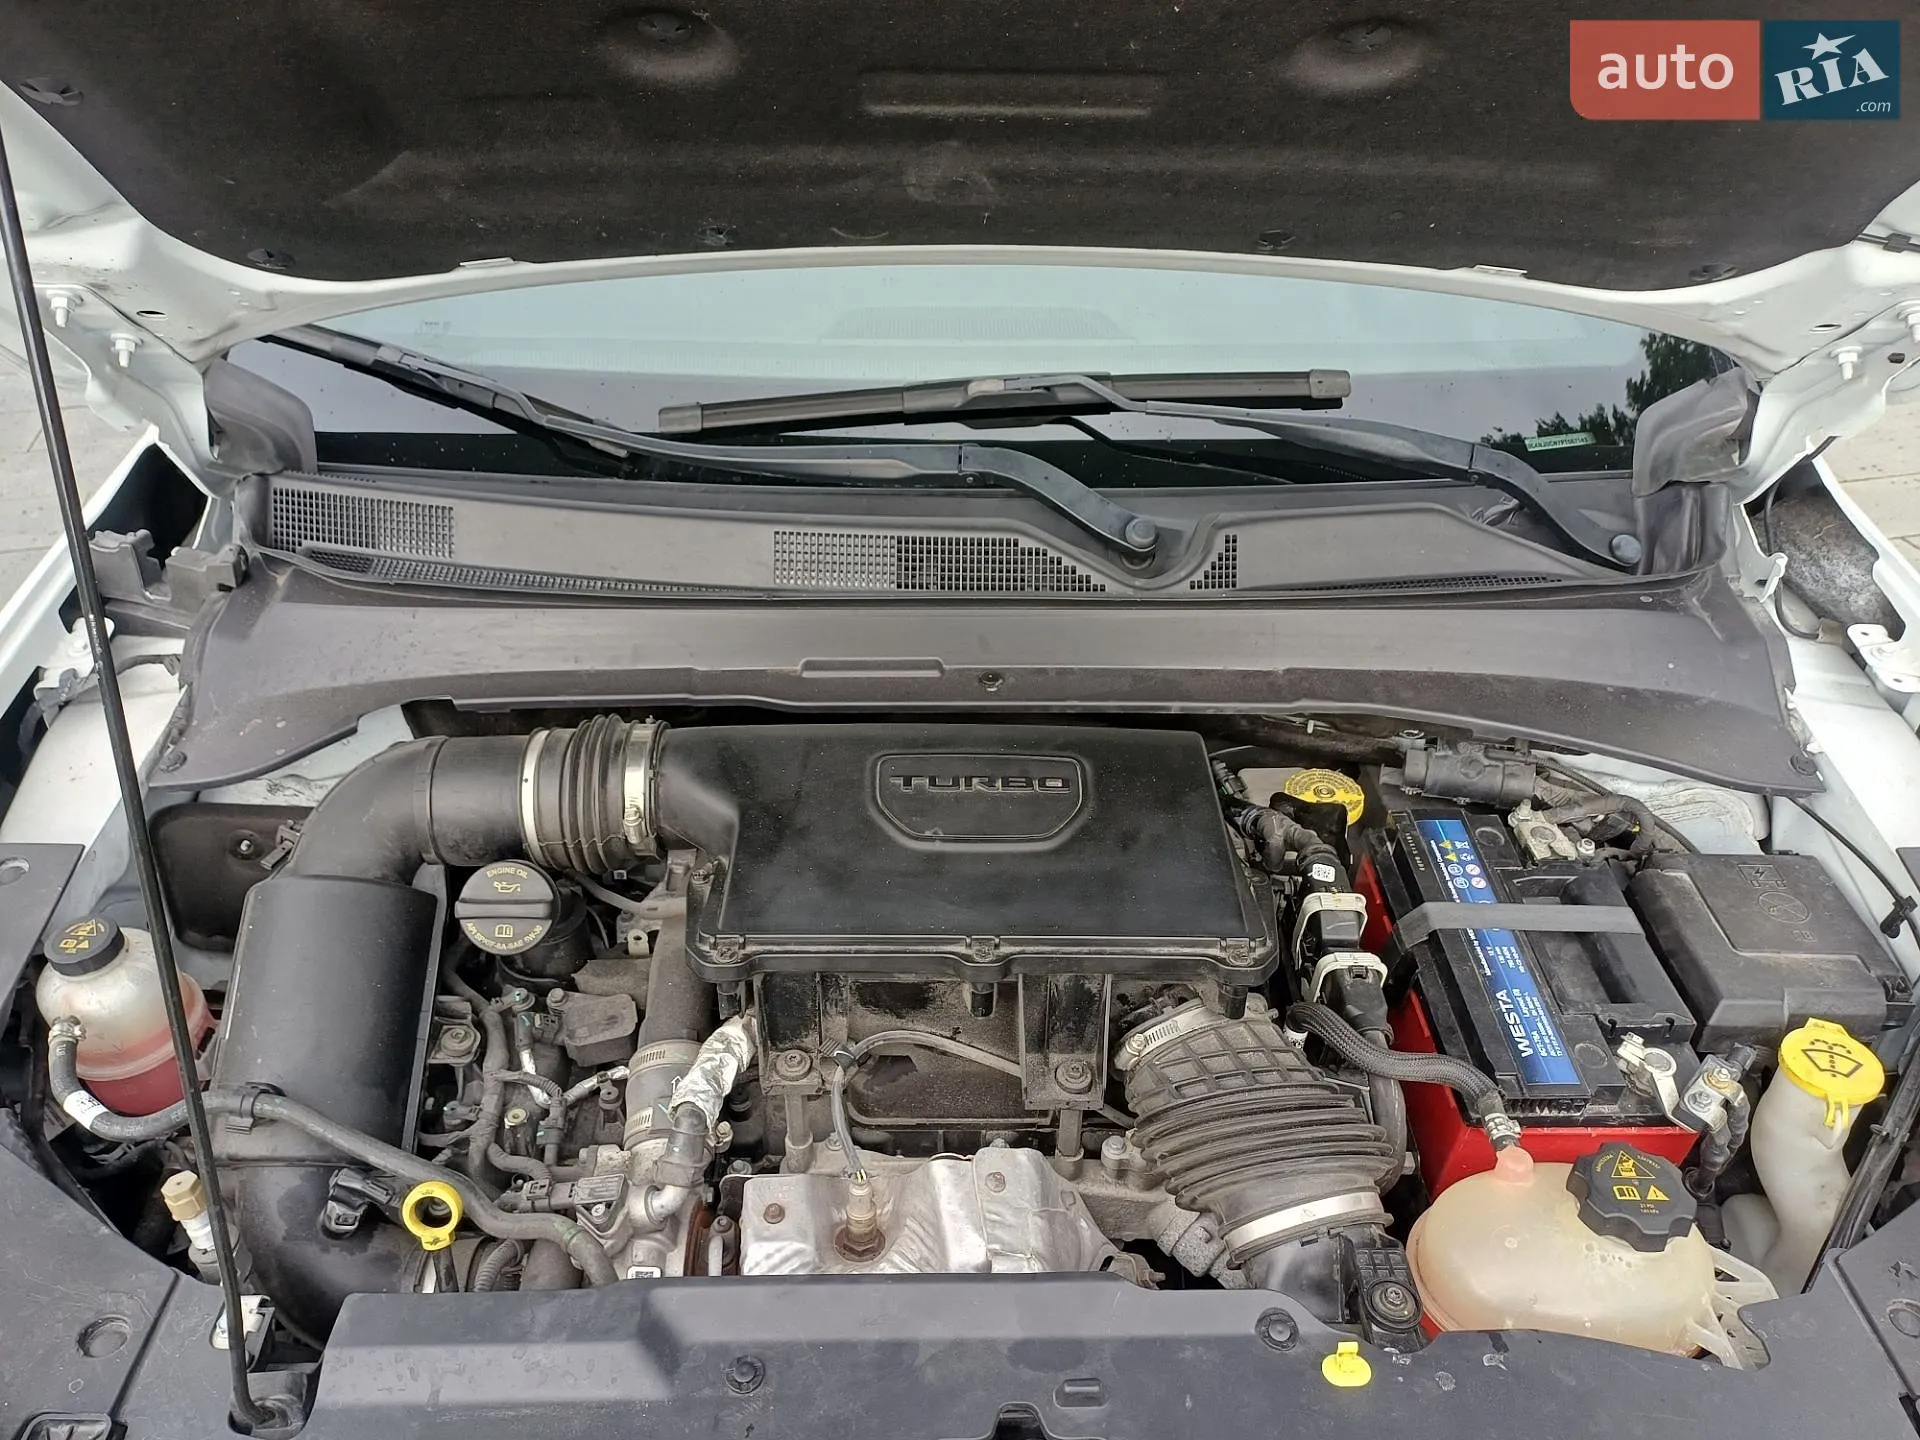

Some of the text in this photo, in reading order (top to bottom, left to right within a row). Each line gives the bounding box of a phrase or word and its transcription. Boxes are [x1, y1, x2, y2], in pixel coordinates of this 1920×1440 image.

[889, 775, 1072, 794] TURBO
[486, 867, 528, 879] ENGINE OIL
[1495, 989, 1534, 1058] WESTA
